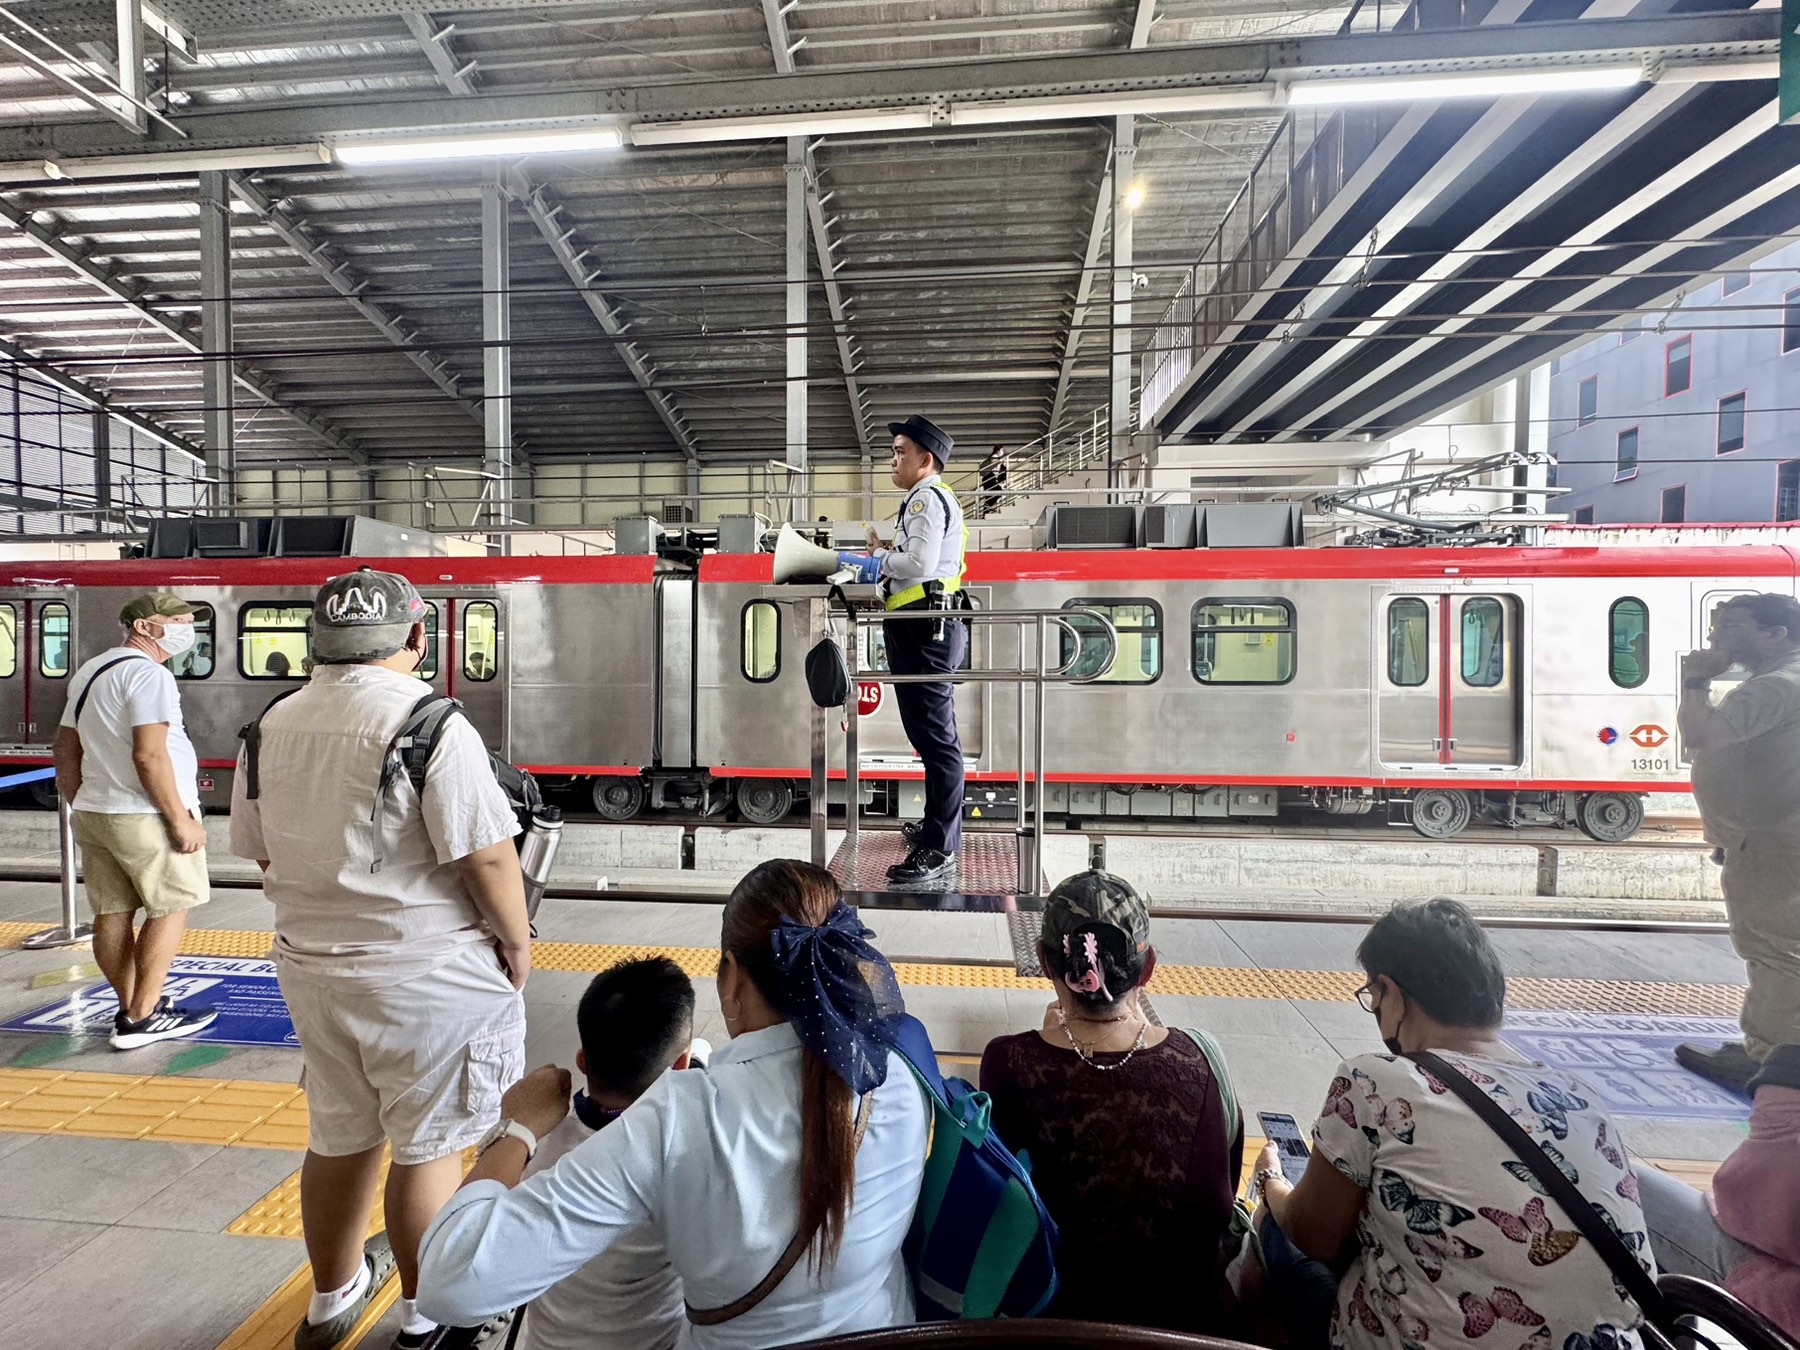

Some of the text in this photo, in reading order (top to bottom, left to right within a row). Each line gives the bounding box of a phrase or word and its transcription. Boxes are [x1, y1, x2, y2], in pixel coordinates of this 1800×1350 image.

[331, 612, 383, 622] CAMBODIA
[1630, 758, 1669, 770] 13101
[1502, 1014, 1607, 1030] PECIAL
